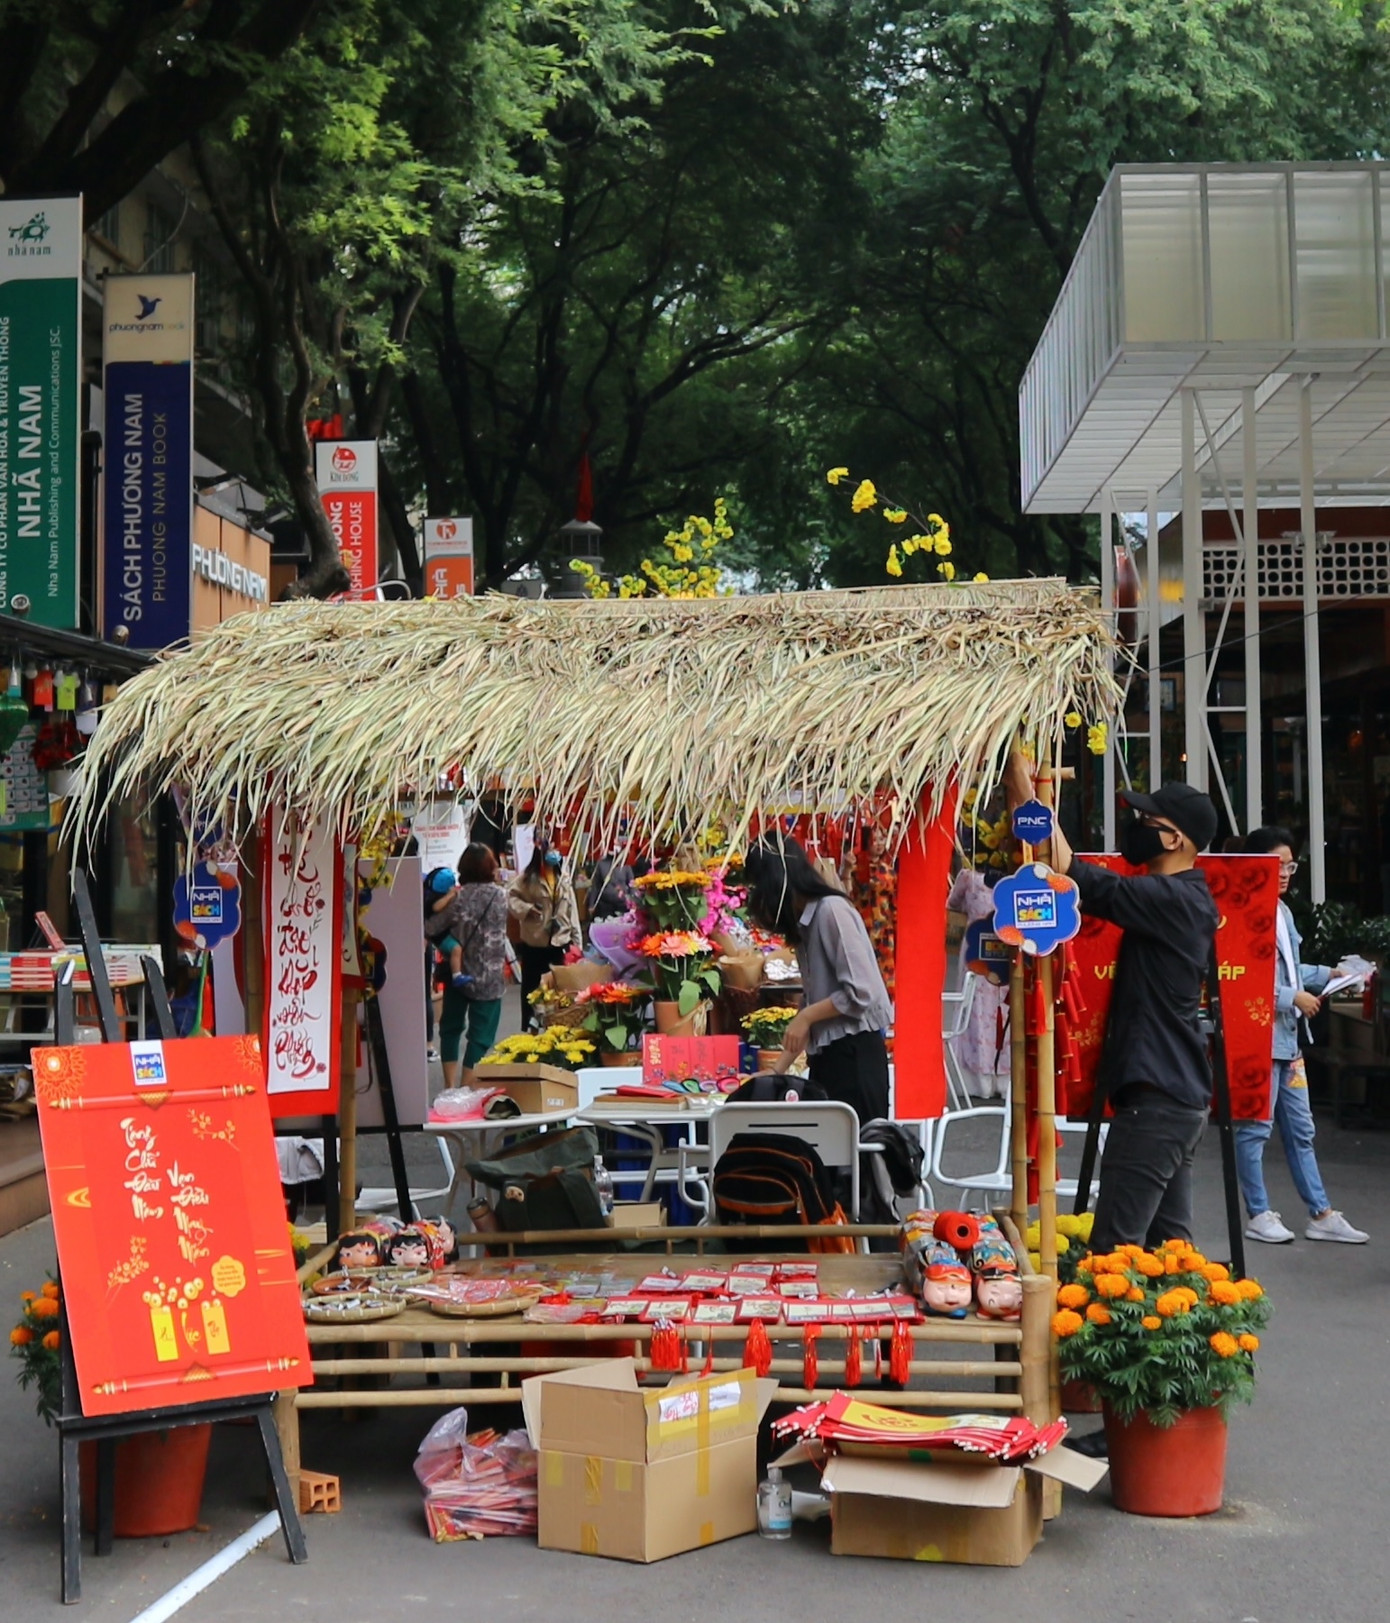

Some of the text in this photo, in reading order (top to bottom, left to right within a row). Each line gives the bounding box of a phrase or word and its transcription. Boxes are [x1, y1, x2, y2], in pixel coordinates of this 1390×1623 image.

[49, 350, 61, 449] Communications
[12, 385, 42, 538] NHÃ NAM
[49, 451, 60, 475] and
[49, 476, 62, 538] Publishing
[119, 393, 143, 622] SÁCH PHƯƠNG NAM
[153, 412, 167, 601] PHUONG NAM BOOK
[350, 502, 362, 546] HOUSE
[48, 541, 59, 570] Nam
[48, 573, 58, 598] Nha
[192, 543, 268, 603] PHƯƠNG NAM
[1017, 817, 1048, 826] PNC
[193, 890, 220, 901] NHÀ
[1018, 893, 1052, 906] NHÀ
[193, 903, 220, 916] SÁCH
[1018, 907, 1052, 921] SÁCH
[135, 1055, 161, 1066] NHÀ
[137, 1065, 163, 1079] SÁCH
